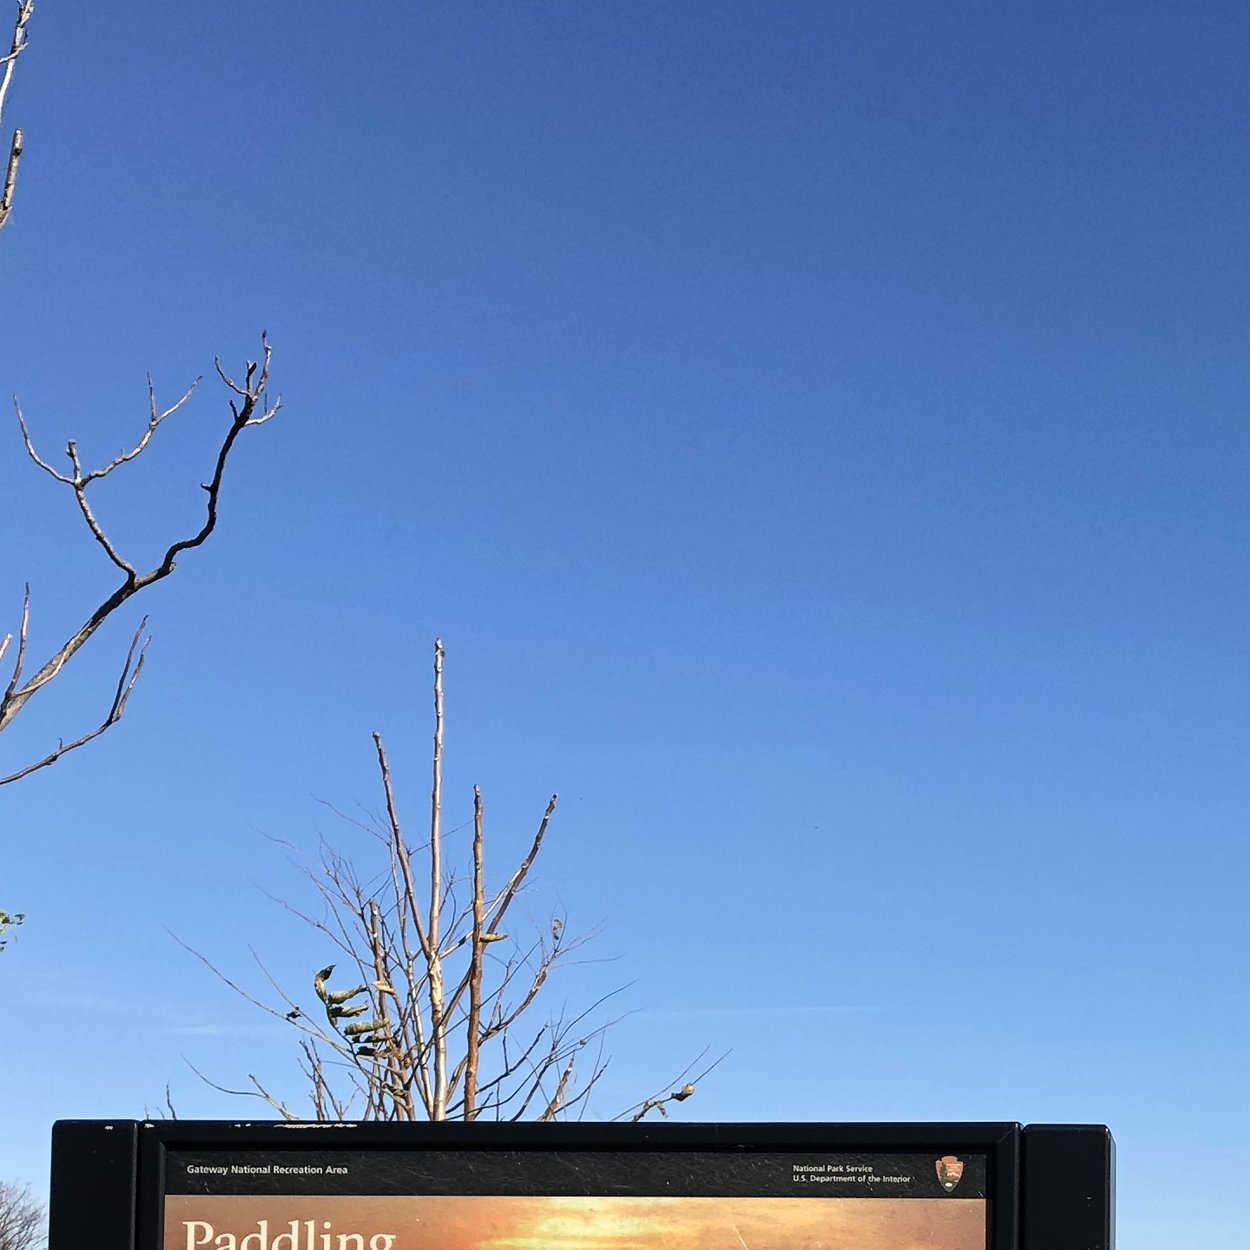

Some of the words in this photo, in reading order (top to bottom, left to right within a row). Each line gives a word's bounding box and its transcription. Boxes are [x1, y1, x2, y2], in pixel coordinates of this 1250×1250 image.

[187, 1165, 228, 1175] Gateway
[231, 1165, 270, 1174] National
[273, 1165, 322, 1174] Recreation
[326, 1165, 348, 1174] Area
[810, 1175, 855, 1183] Department
